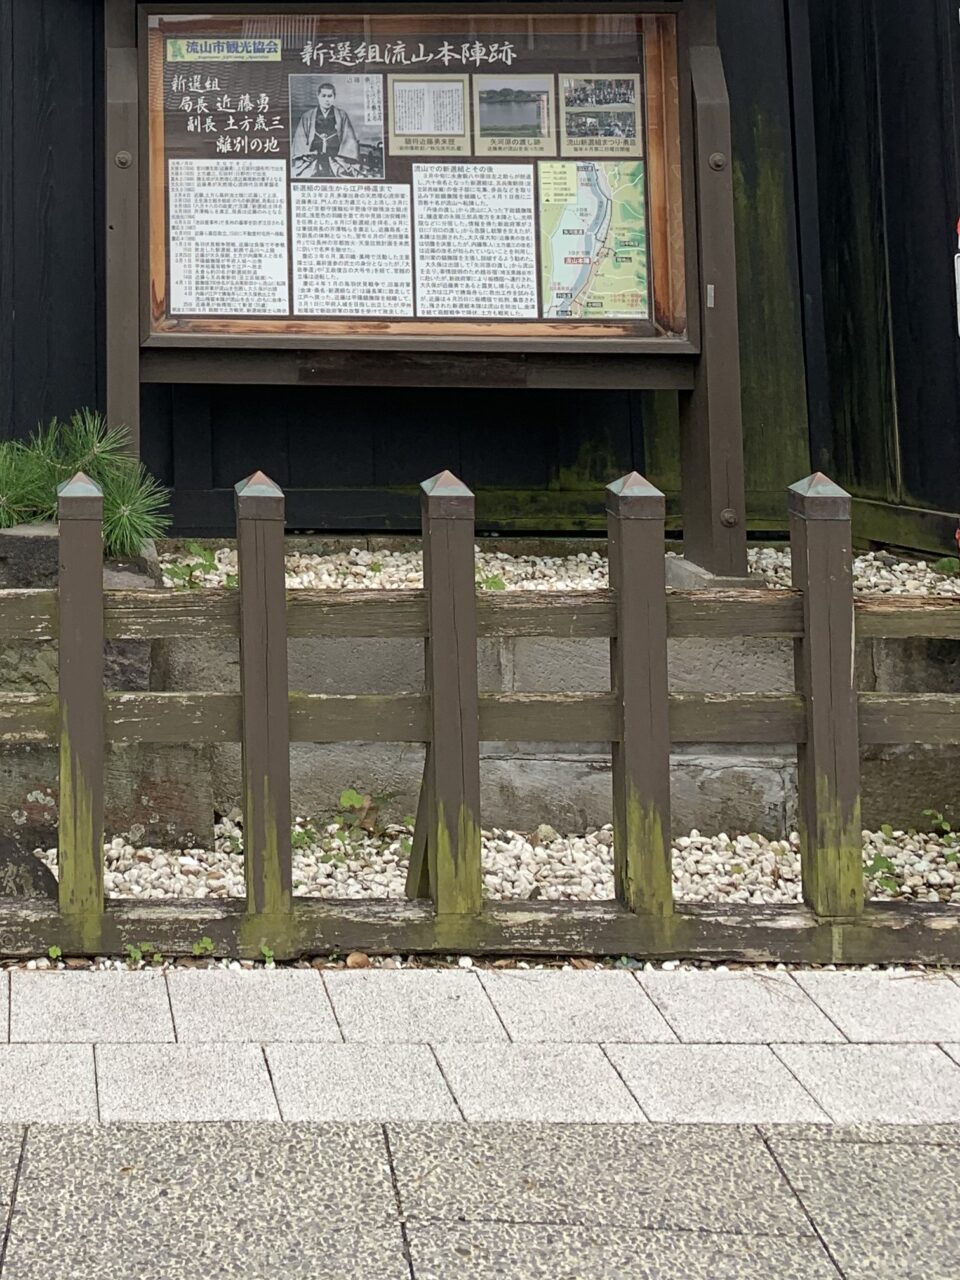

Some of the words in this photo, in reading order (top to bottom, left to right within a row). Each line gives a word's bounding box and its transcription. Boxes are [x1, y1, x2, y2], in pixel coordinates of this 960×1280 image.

[186, 40, 278, 54] 流山市観光協会
[300, 41, 517, 66] 新選組流山本陣跡
[171, 74, 221, 93] 新選組
[179, 96, 209, 113] 局長
[216, 93, 270, 113] 近藤勇
[187, 116, 217, 133] 副長
[224, 114, 284, 132] 土方歳三
[216, 135, 280, 154] 離別の地
